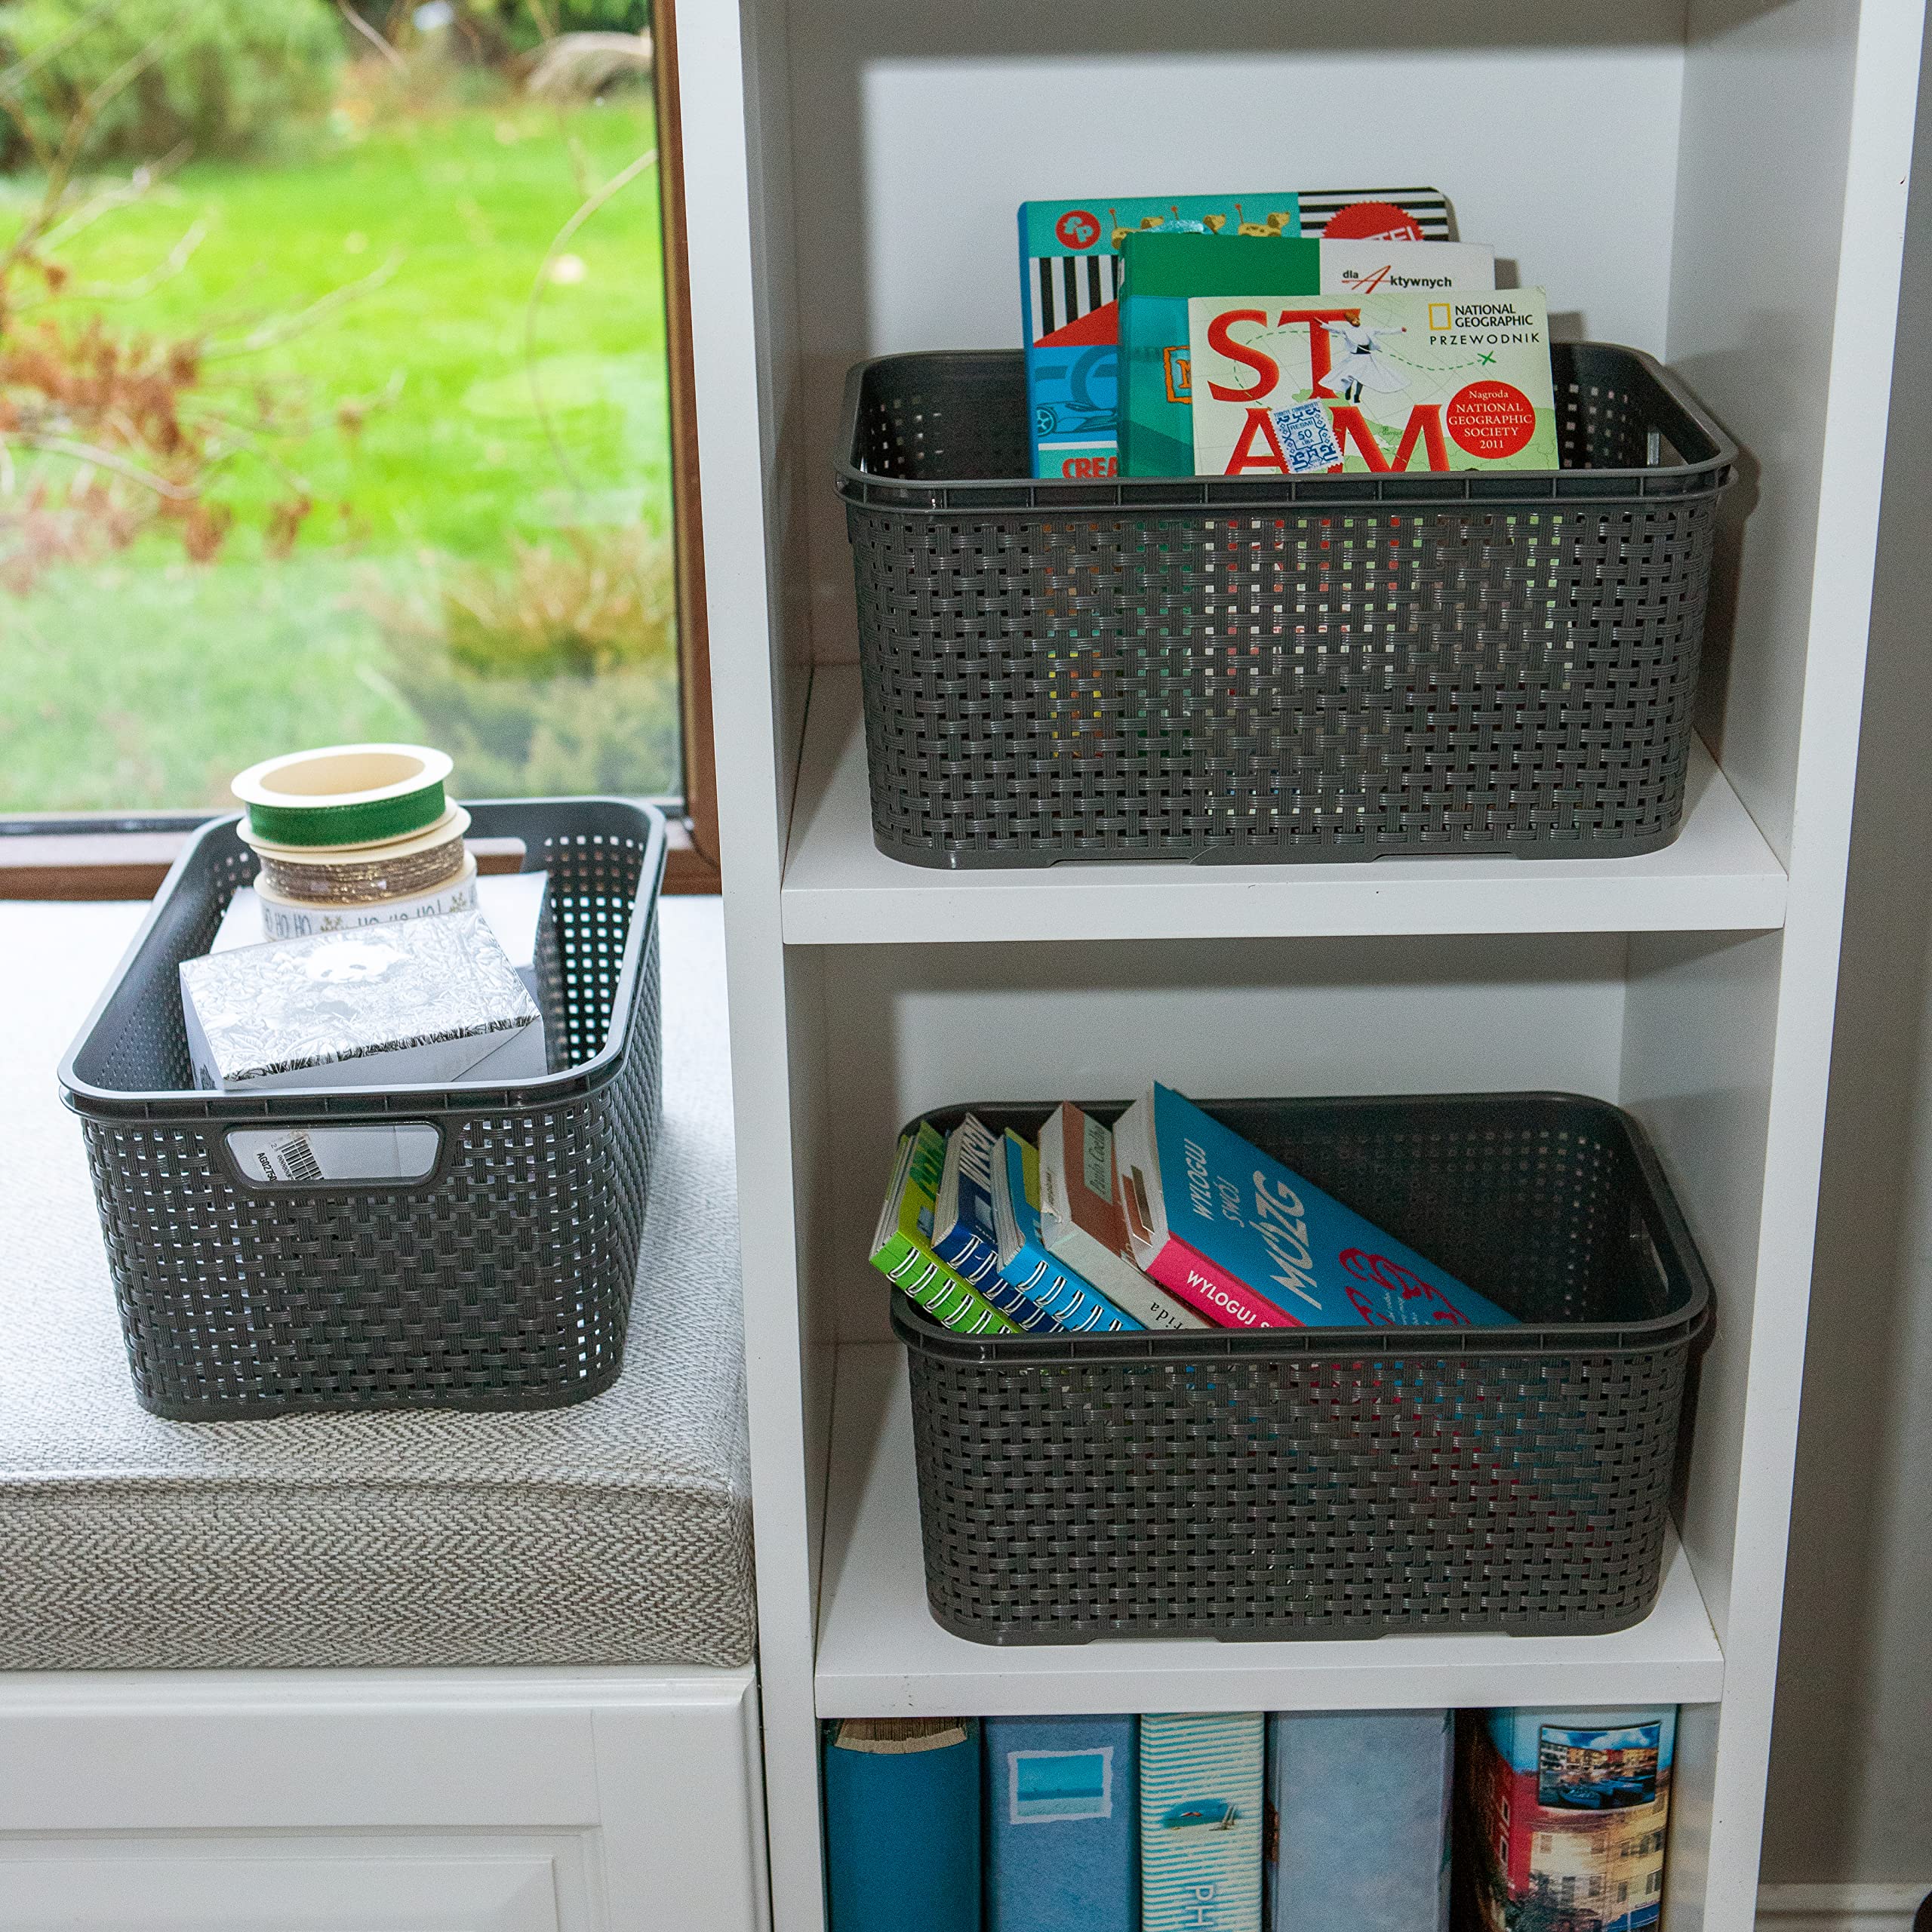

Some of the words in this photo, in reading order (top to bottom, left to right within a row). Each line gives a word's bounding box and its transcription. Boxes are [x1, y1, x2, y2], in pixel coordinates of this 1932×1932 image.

[1342, 265, 1452, 294] Aktywnych
[1343, 270, 1359, 279] dla
[1455, 303, 1516, 315] NATIONAL
[1455, 315, 1534, 328] GEOGRAPHIC
[1430, 333, 1540, 345] PRZEWODNIK
[1207, 308, 1361, 402] ST
[1469, 390, 1509, 400] Nagroda
[1457, 403, 1523, 413] NATIONAL
[1449, 414, 1533, 425] GEOGRAPHIC
[1297, 429, 1312, 440] 50
[1464, 427, 1518, 437] SOCIETY
[1480, 440, 1504, 449] 2011
[1184, 1138, 1214, 1221] WYLOGUJ
[1213, 1176, 1244, 1228] SWÓJ
[1249, 1171, 1322, 1311] MÓZG
[1186, 1270, 1257, 1325] WYLOGUJ
[1150, 1302, 1183, 1330] rida
